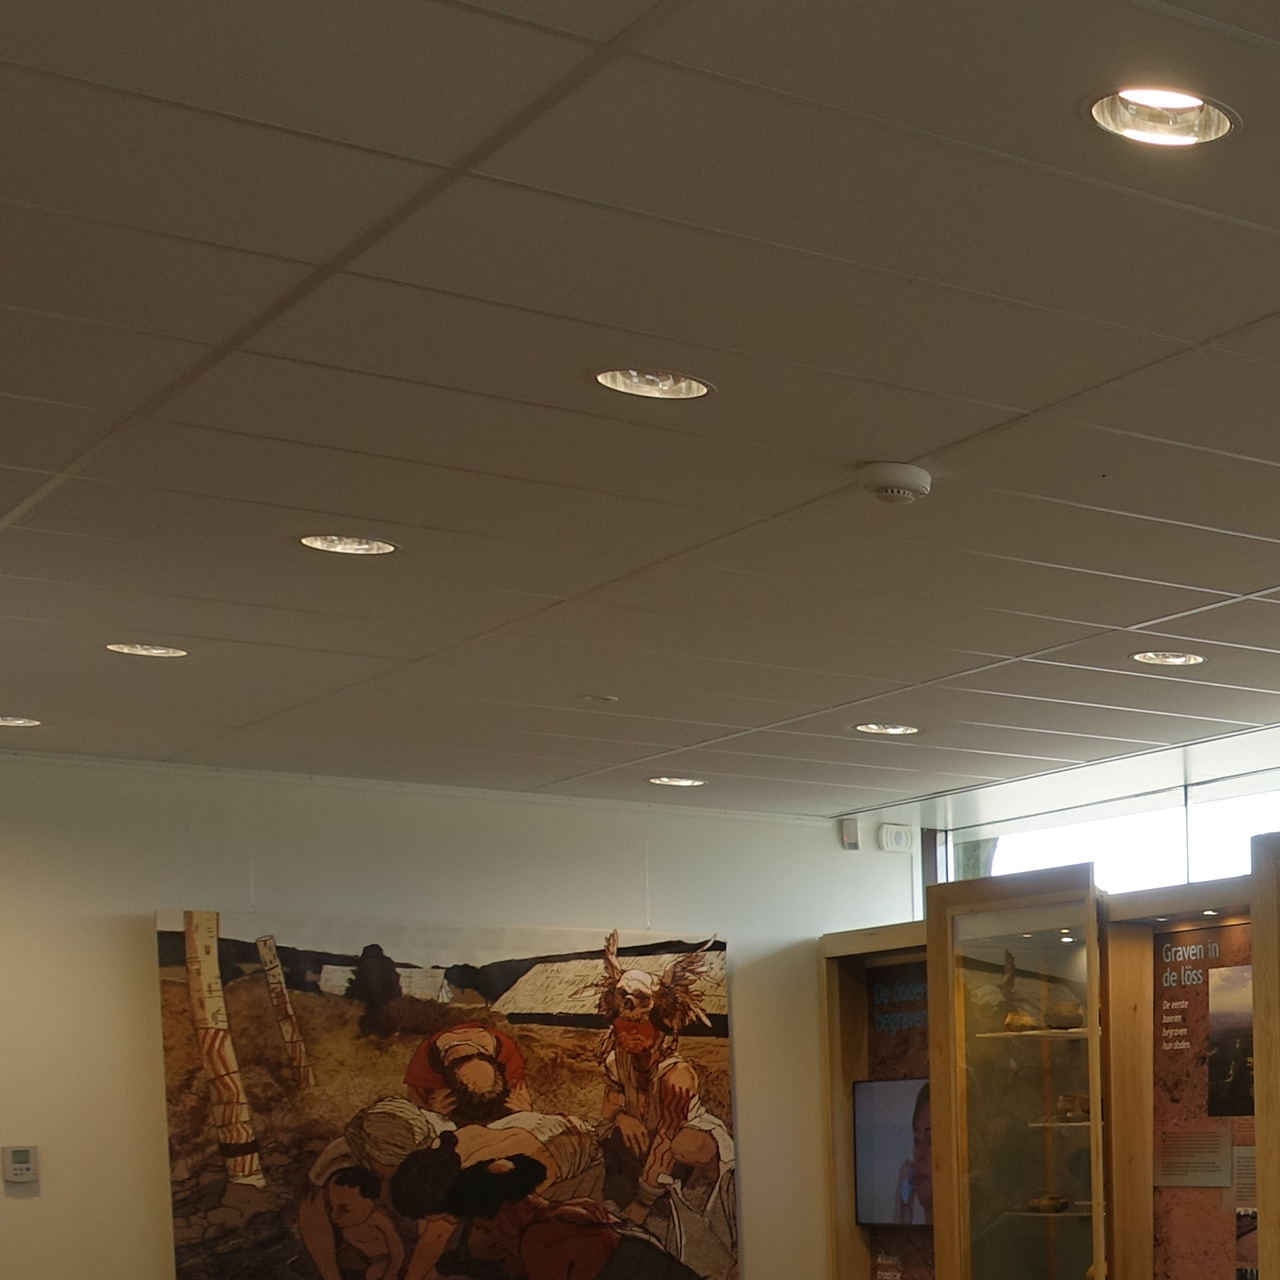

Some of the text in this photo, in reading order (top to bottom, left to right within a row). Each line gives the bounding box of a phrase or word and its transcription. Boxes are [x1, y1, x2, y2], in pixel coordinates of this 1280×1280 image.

[1162, 939, 1219, 963] Graven in
[1162, 965, 1203, 987] de löss
[874, 983, 890, 1004] De
[1162, 999, 1189, 1010] De eerste
